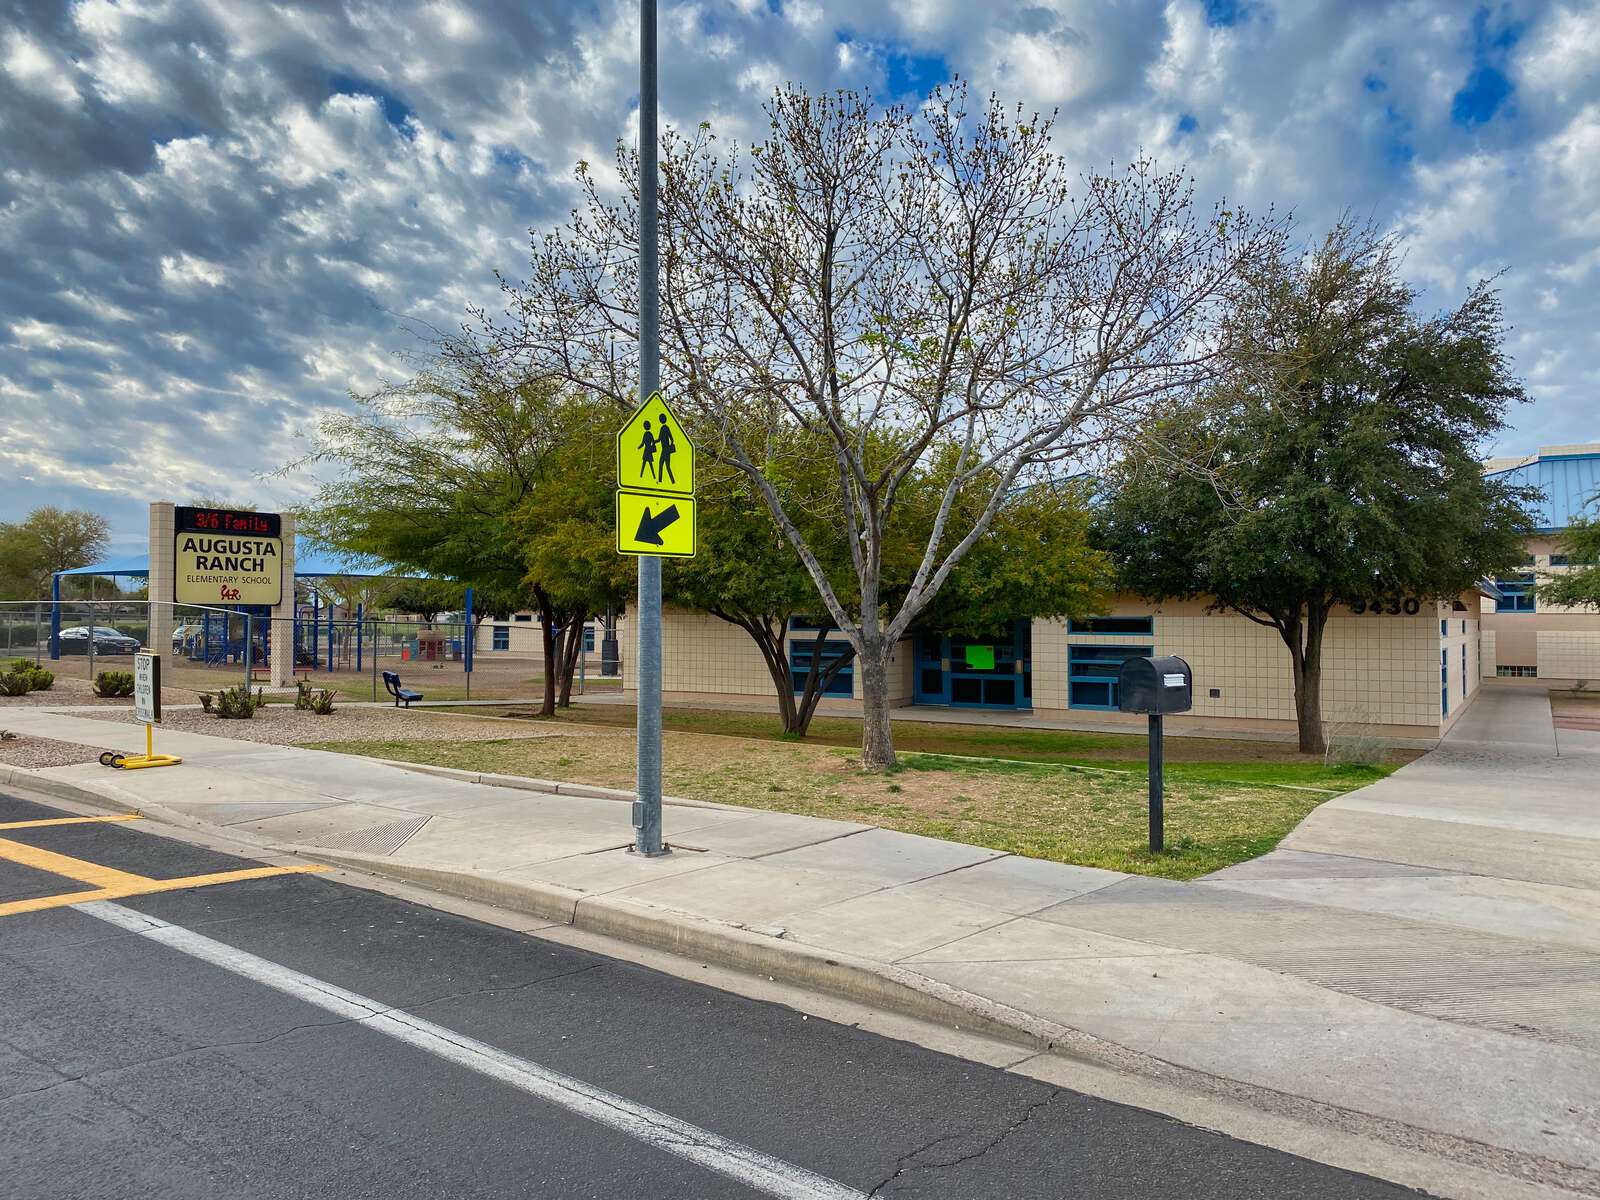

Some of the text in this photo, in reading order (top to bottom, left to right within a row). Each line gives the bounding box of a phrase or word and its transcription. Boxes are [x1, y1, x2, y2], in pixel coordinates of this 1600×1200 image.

[183, 538, 276, 556] AUGUSTA
[196, 556, 264, 572] RANCH
[187, 575, 272, 585] ELEMENTARY SCHOOL
[1351, 597, 1420, 615] 9430
[137, 657, 150, 671] STOP
